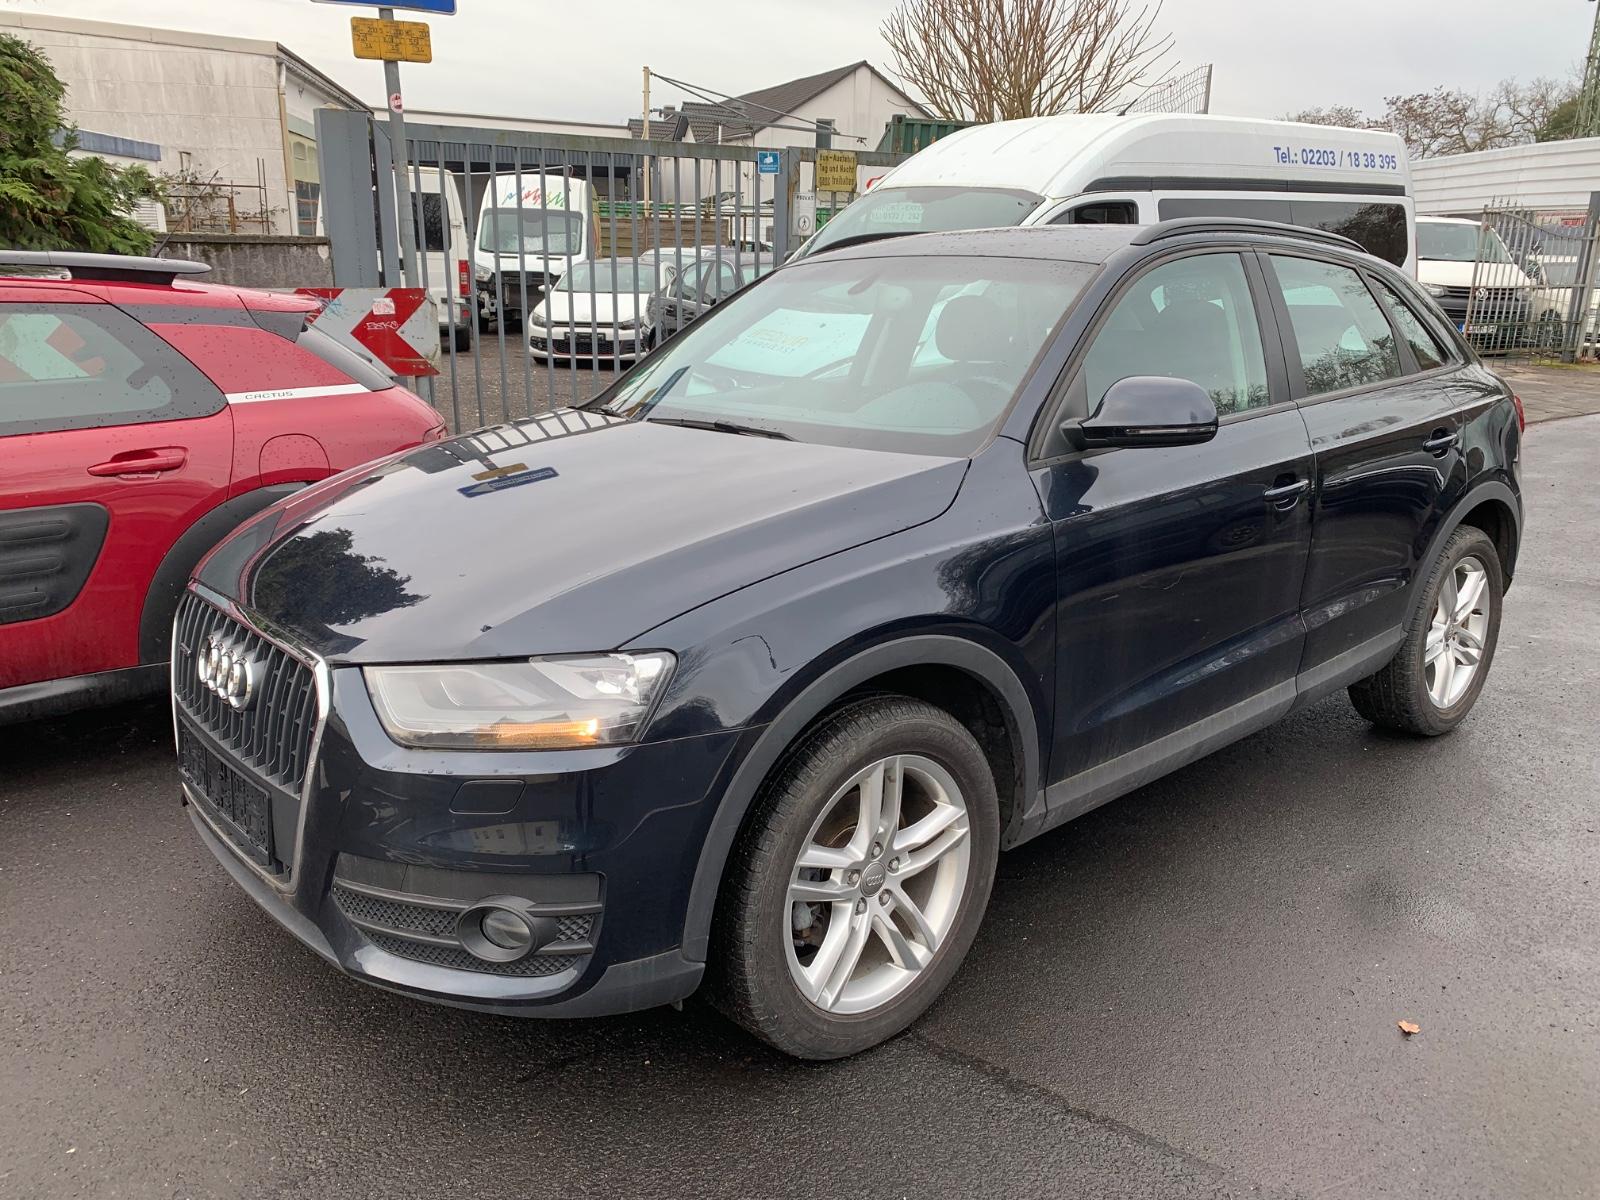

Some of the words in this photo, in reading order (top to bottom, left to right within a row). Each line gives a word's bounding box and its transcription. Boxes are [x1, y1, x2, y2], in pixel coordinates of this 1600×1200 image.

[1273, 146, 1298, 164] Tel.:
[1301, 148, 1336, 166] 02203
[1340, 150, 1344, 168] /
[1347, 151, 1360, 168] 18
[1363, 152, 1376, 169] 38
[1379, 154, 1397, 170] 395
[819, 163, 828, 174] Tag
[829, 164, 839, 173] und
[839, 164, 855, 173] Nacht
[244, 391, 294, 400] CACTUS
